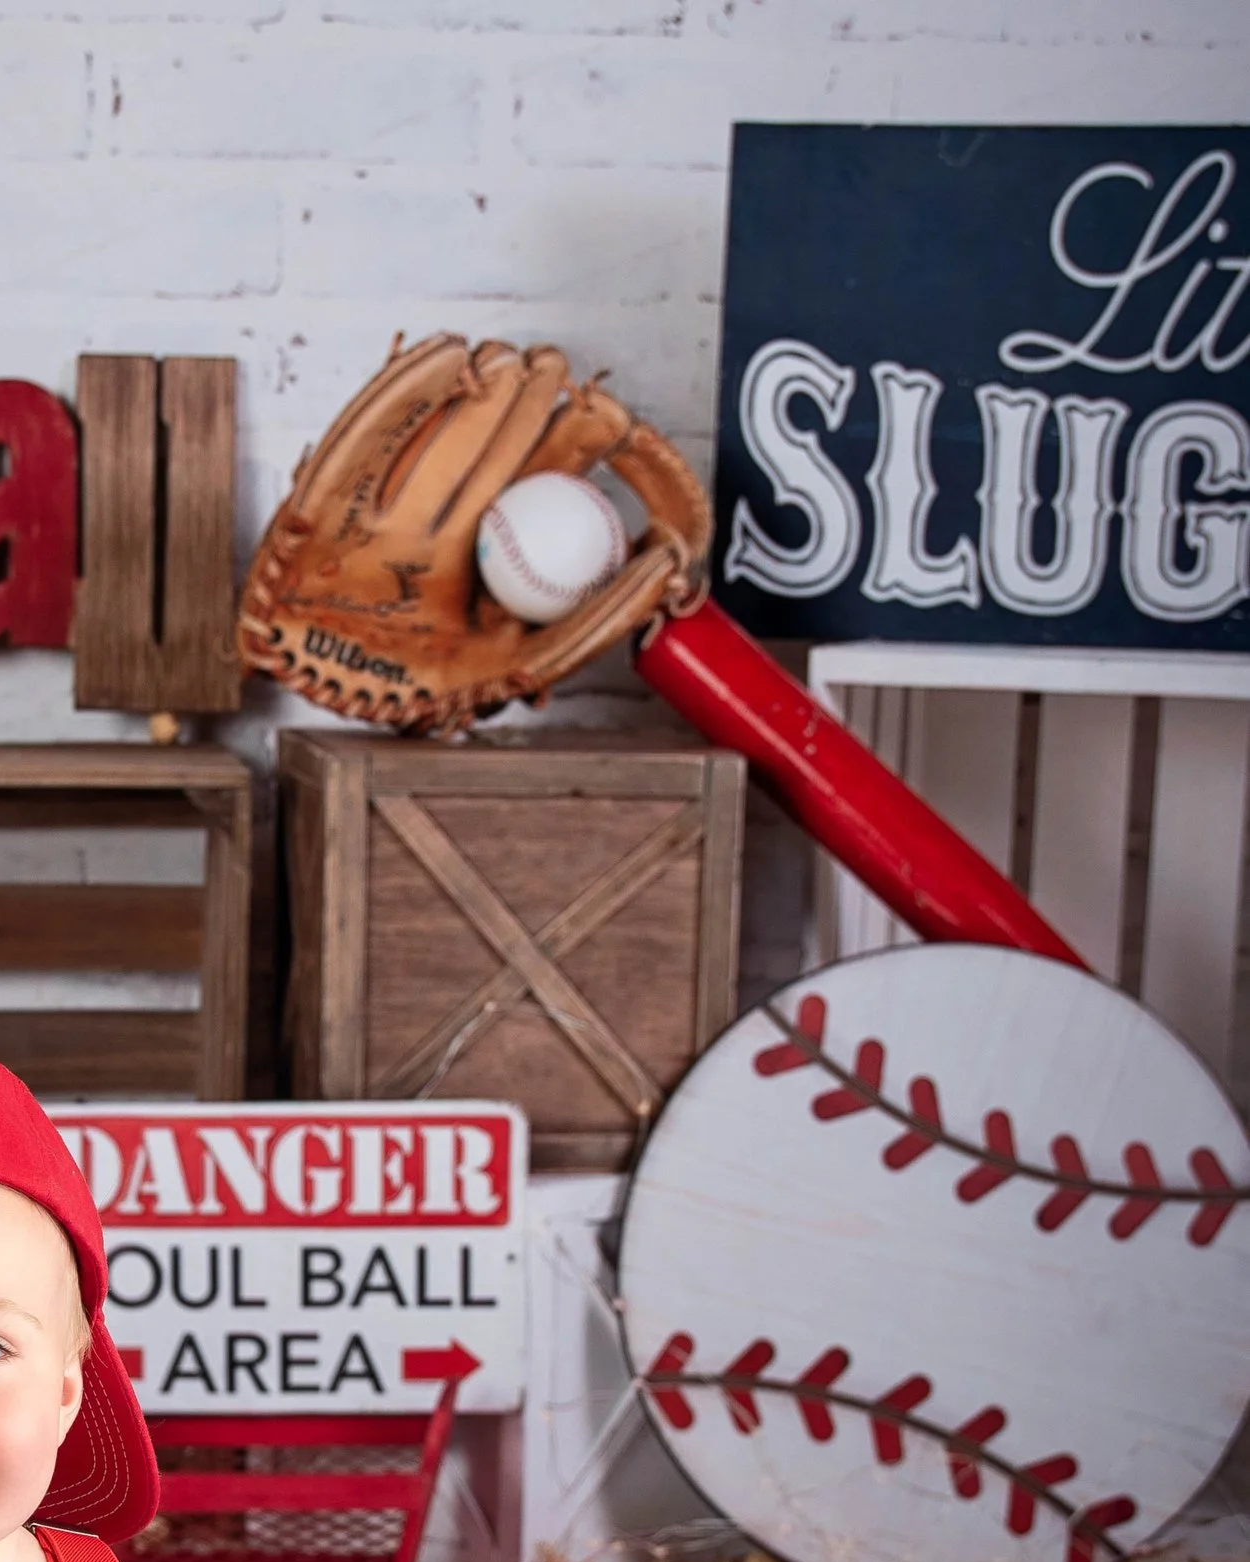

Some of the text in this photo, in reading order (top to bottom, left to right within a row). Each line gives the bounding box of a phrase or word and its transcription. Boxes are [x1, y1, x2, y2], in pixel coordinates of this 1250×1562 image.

[725, 338, 1250, 623] SLUG
[304, 624, 407, 685] Wilson
[56, 1123, 502, 1216] DANGER
[107, 1244, 498, 1310] OUL BALL
[159, 1332, 387, 1395] AREA
